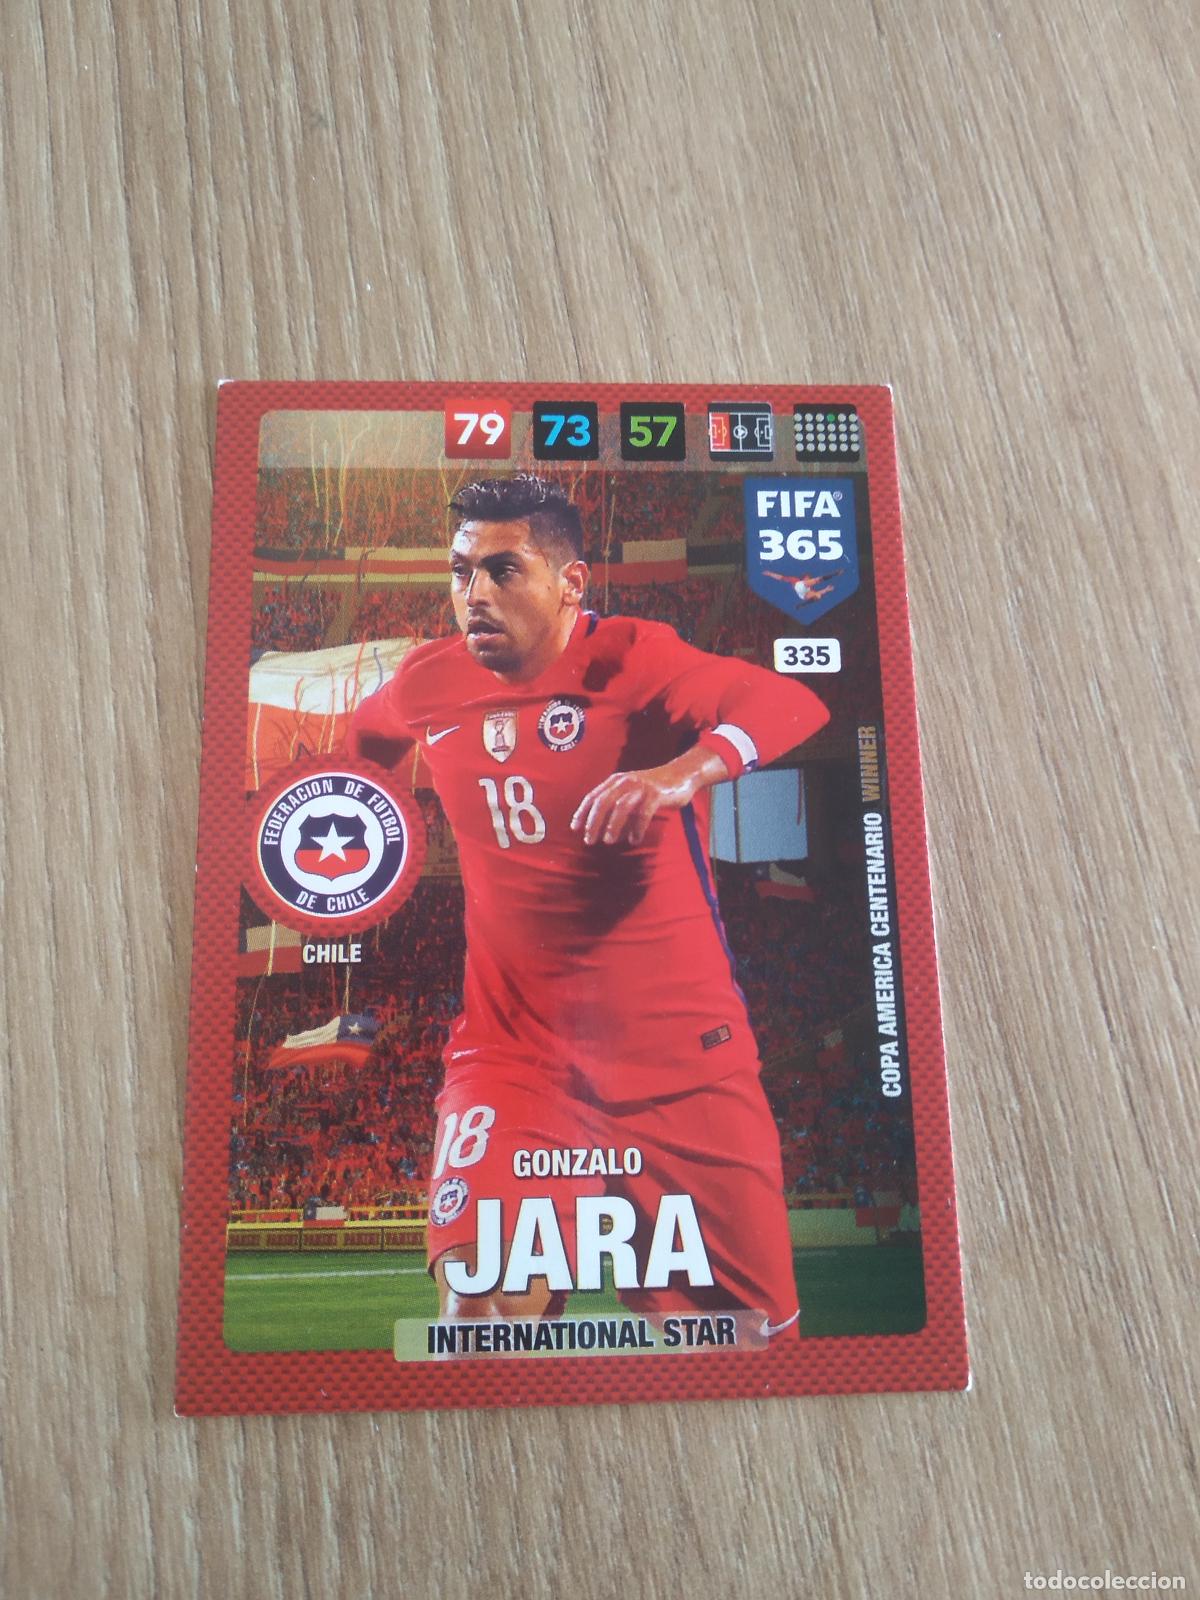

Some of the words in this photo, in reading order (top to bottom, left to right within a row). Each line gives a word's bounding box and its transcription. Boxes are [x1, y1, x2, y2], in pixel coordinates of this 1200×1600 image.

[453, 413, 505, 447] 79
[540, 414, 591, 446] 73
[628, 415, 677, 447] 57
[757, 490, 842, 518] FIFA
[758, 529, 844, 561] 365
[783, 645, 831, 667] 335
[858, 725, 881, 802] WINNER
[264, 779, 333, 845] FEDERACION
[344, 780, 365, 798] DE
[367, 793, 401, 845] FUTBOL
[478, 775, 546, 849] 18
[863, 812, 891, 937] CENTENARIO
[296, 890, 318, 909] DE
[326, 888, 370, 912] CHILE
[303, 943, 362, 964] CHILE
[871, 942, 897, 1039] AMERICA
[882, 1042, 902, 1098] COPA
[433, 1105, 495, 1180] 18
[513, 1147, 642, 1177] GONZALO
[443, 1194, 715, 1295] JARA
[427, 1318, 655, 1354] INTERNATIONAL
[663, 1316, 735, 1347] STAR
